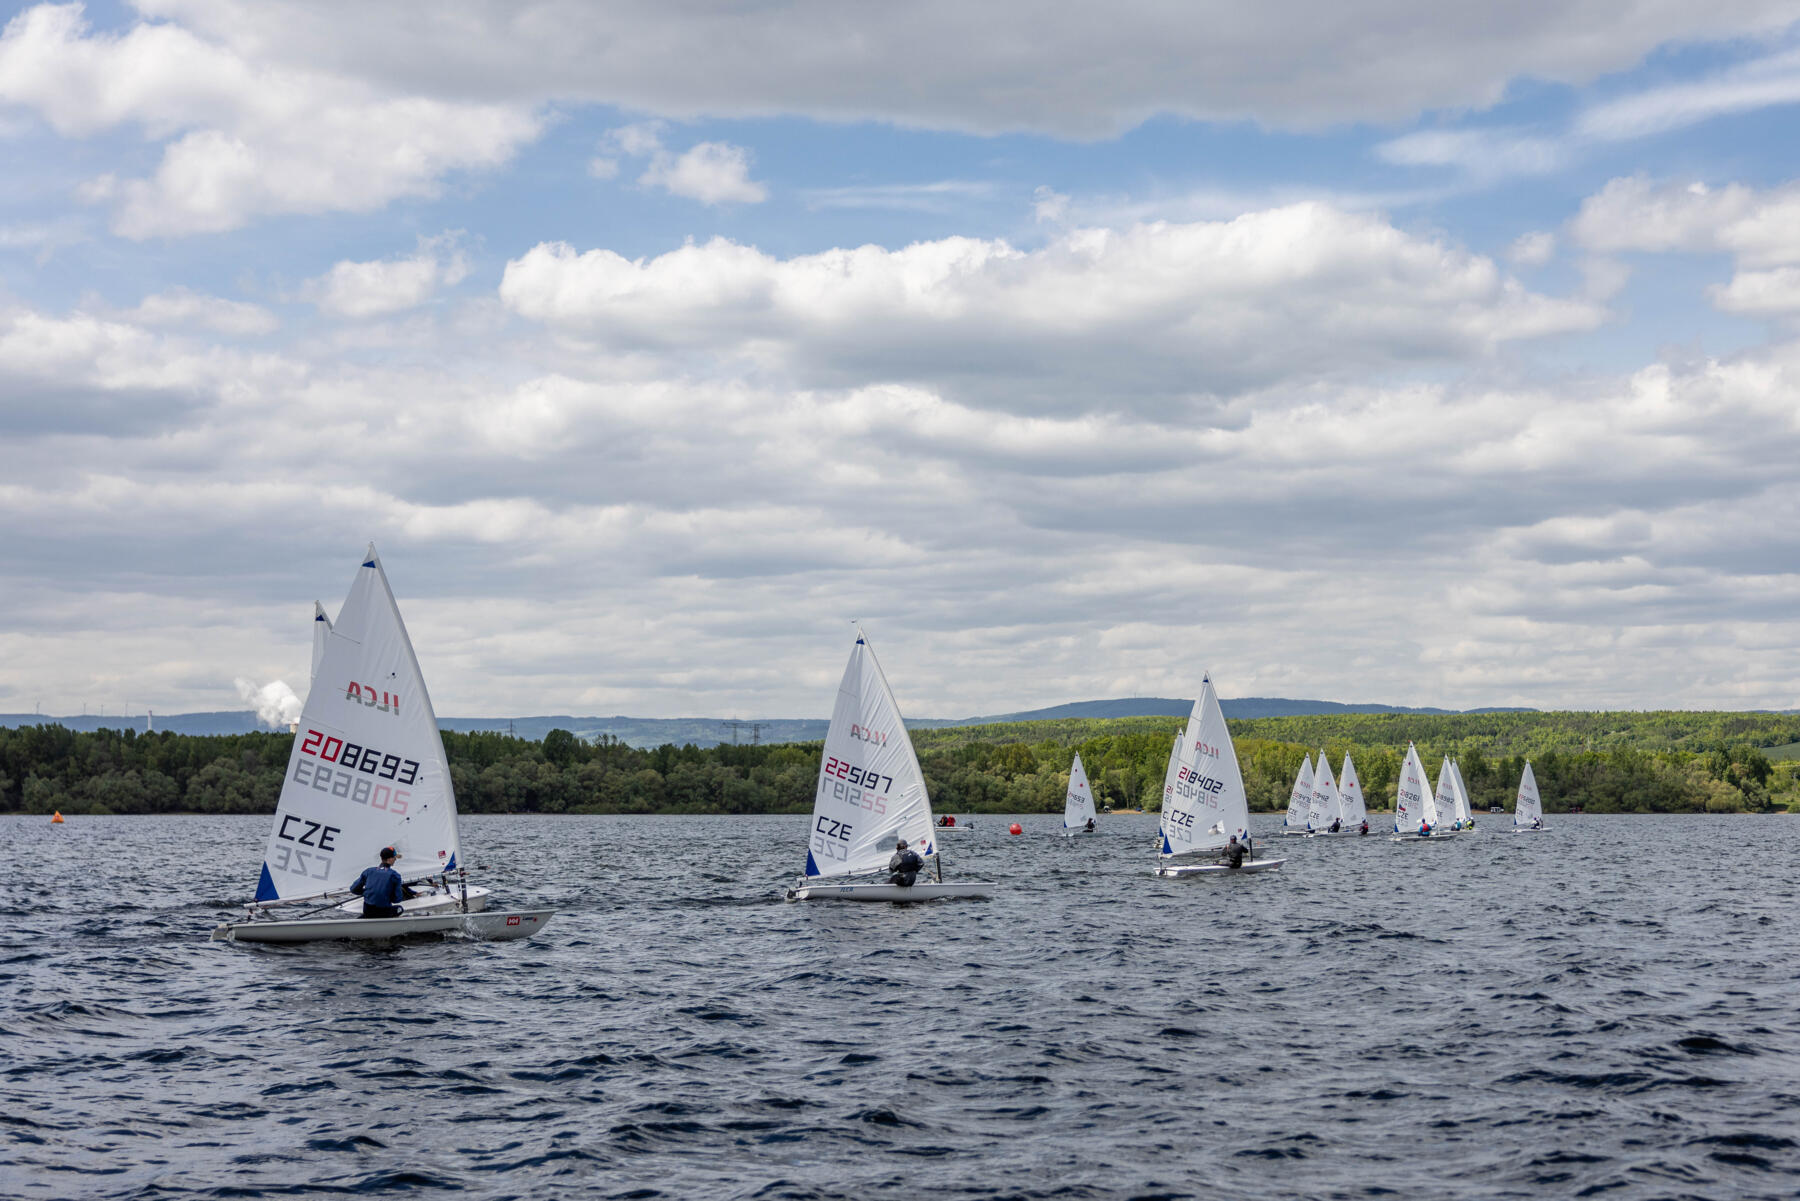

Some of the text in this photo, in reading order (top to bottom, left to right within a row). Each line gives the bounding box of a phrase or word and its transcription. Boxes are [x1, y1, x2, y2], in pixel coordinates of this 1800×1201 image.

[301, 729, 420, 785] 208693
[825, 756, 893, 794] 225197
[1178, 766, 1223, 794] 218402
[278, 814, 341, 852] CZE
[816, 815, 853, 841] CZE
[1171, 809, 1195, 828] CZE
